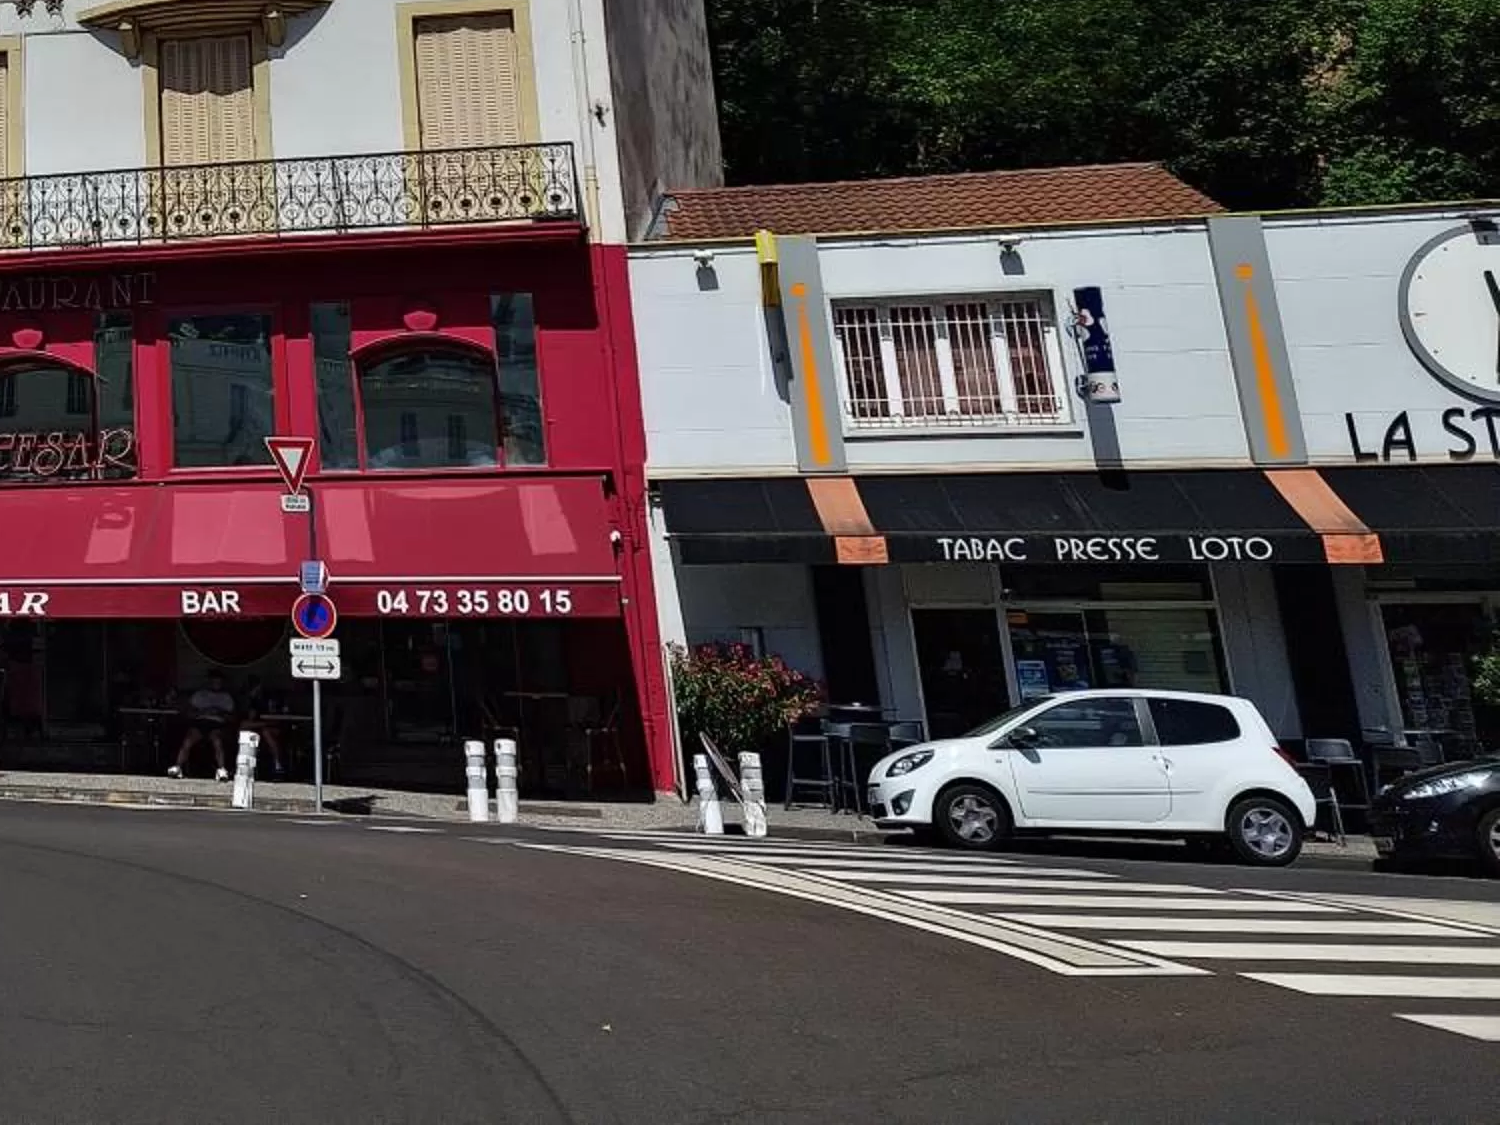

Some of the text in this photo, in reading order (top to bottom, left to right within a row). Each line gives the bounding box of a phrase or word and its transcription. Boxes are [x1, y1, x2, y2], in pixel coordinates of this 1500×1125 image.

[1345, 410, 1417, 463] LA
[937, 536, 1273, 561] TABAC PRESSE LOTO
[181, 590, 241, 614] BAR
[376, 589, 572, 614] 04 73 35 80 15
